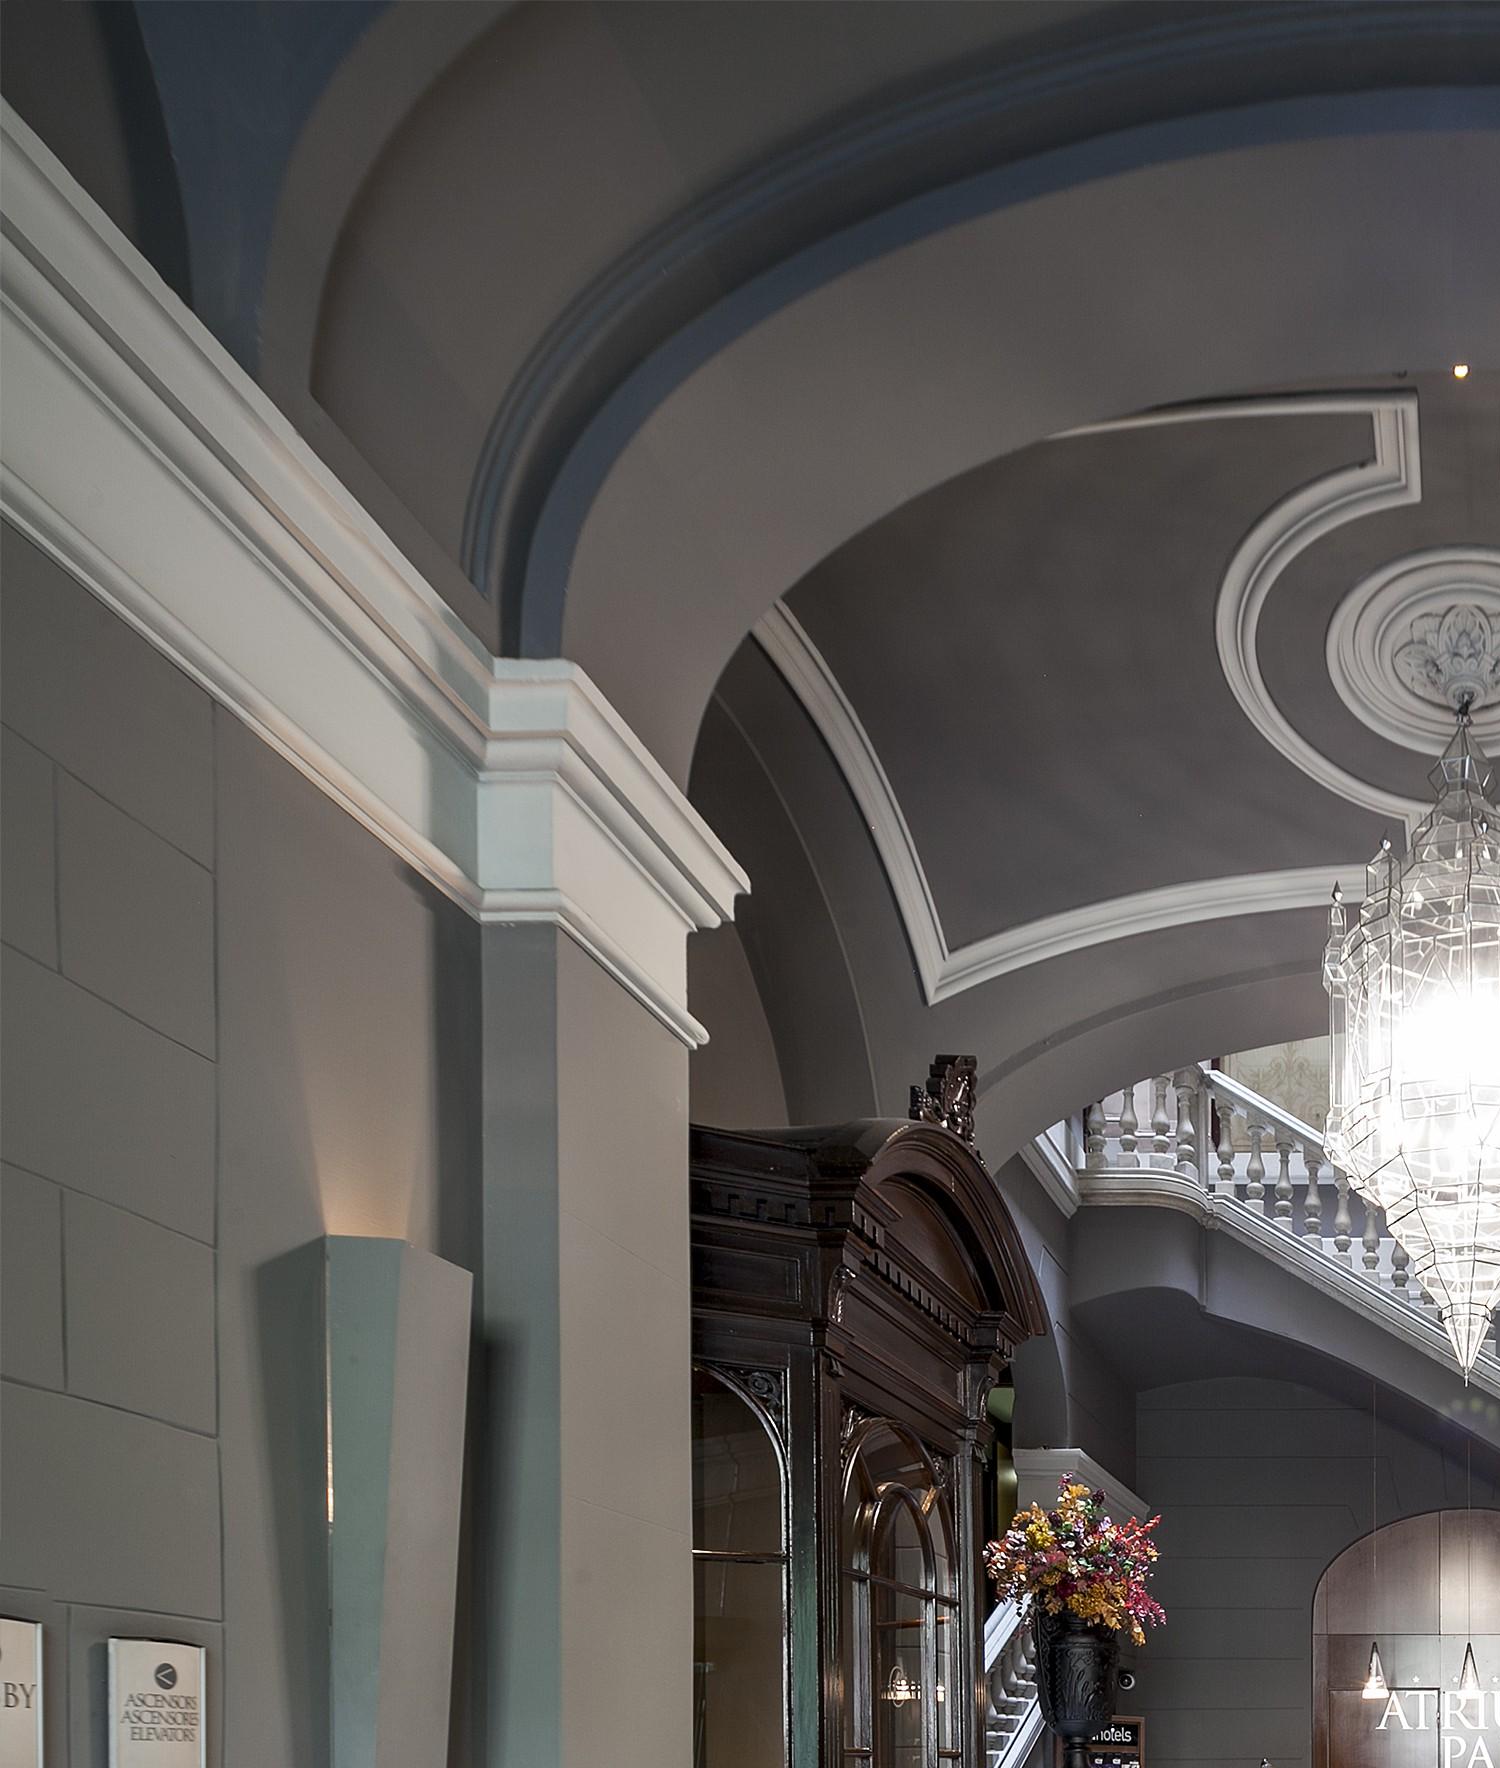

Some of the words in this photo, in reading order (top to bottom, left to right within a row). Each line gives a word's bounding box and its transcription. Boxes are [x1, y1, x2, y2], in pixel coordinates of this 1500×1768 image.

[124, 1693, 198, 1711] ASCENSORS
[119, 1709, 199, 1727] ASCENSORES
[129, 1726, 197, 1743] ELEVATORS
